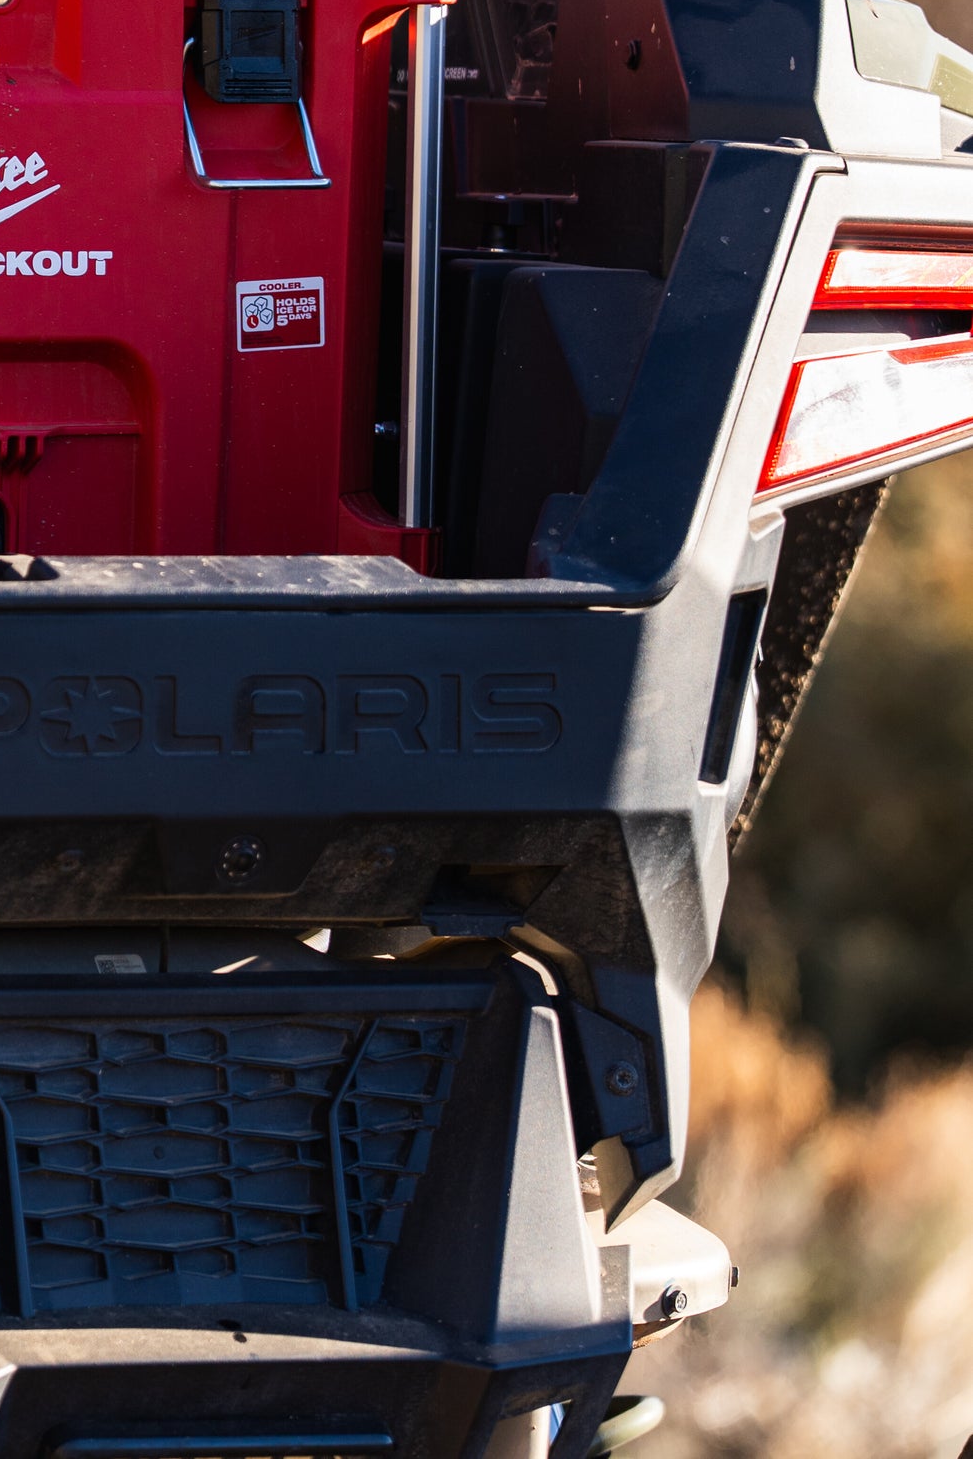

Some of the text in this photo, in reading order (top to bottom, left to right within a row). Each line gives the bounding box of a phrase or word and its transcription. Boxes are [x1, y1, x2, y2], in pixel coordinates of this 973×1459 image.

[276, 297, 316, 307] HOLDS
[276, 305, 317, 314] ICE FOR
[276, 315, 289, 327] 5
